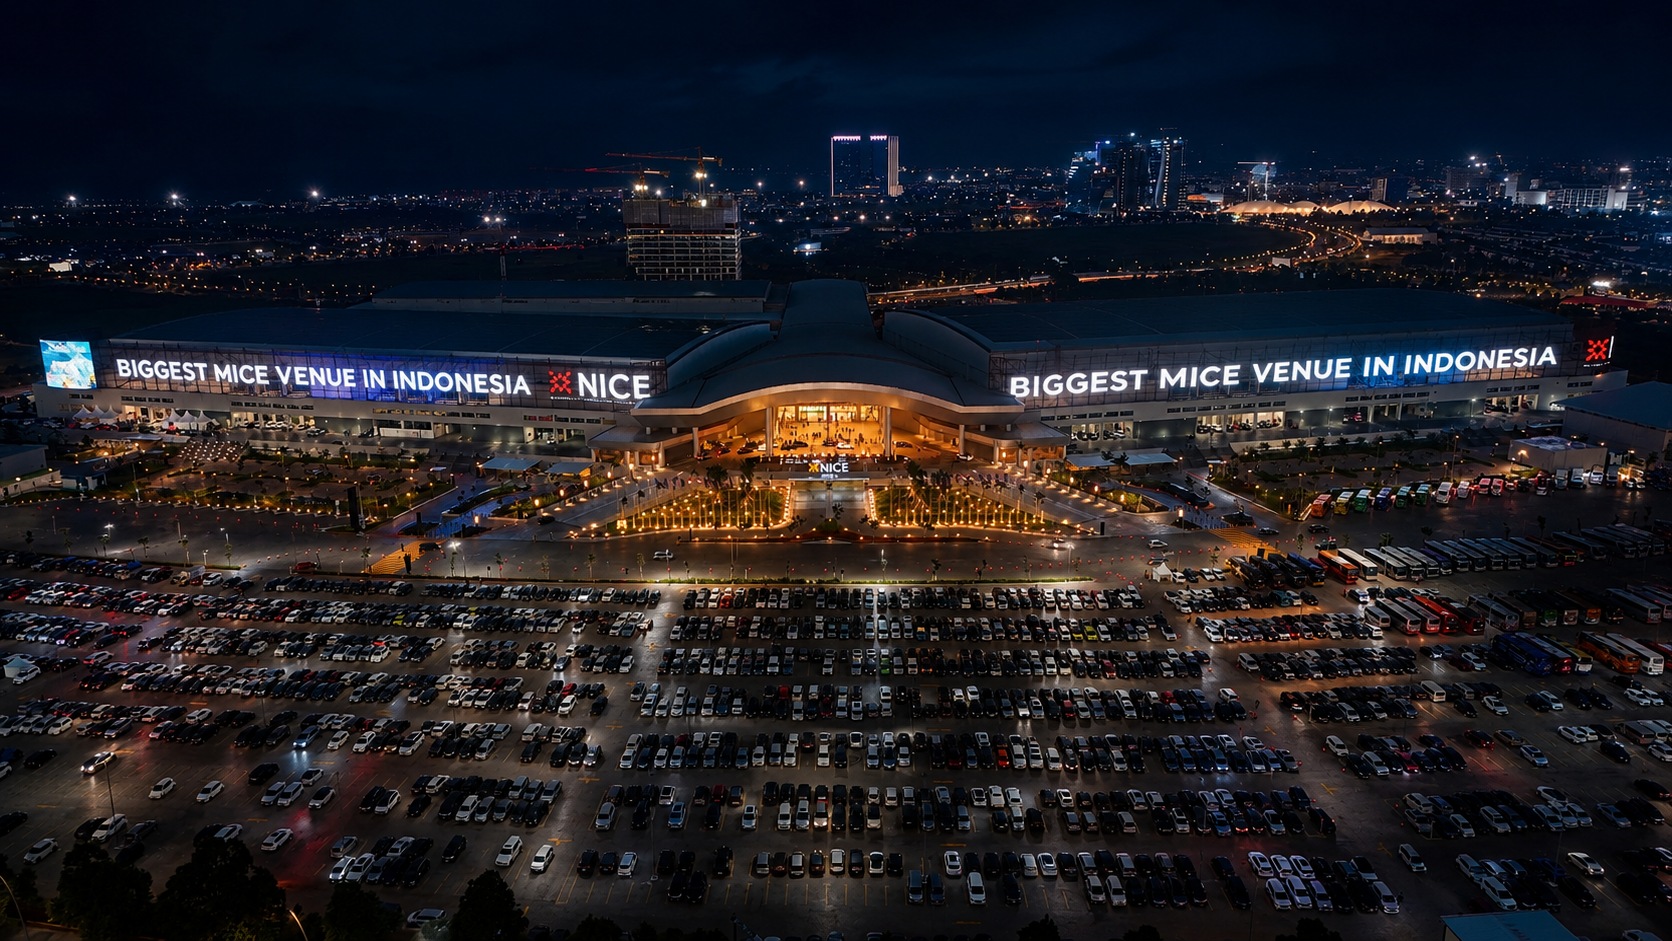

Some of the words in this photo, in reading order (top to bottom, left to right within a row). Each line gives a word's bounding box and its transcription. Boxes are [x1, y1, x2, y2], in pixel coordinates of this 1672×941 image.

[116, 359, 207, 381] BIGGEST
[213, 364, 270, 384] MICE
[275, 366, 356, 387] VENUE
[363, 369, 386, 388] IN
[393, 371, 532, 395] INDONESIA
[578, 373, 651, 399] NICE
[1010, 370, 1148, 398] BIGGEST
[1160, 365, 1240, 388] MICE
[1253, 358, 1352, 383] VENUE
[1364, 356, 1395, 377] IN
[1405, 347, 1557, 375] INDONESIA
[820, 463, 849, 472] NICE
